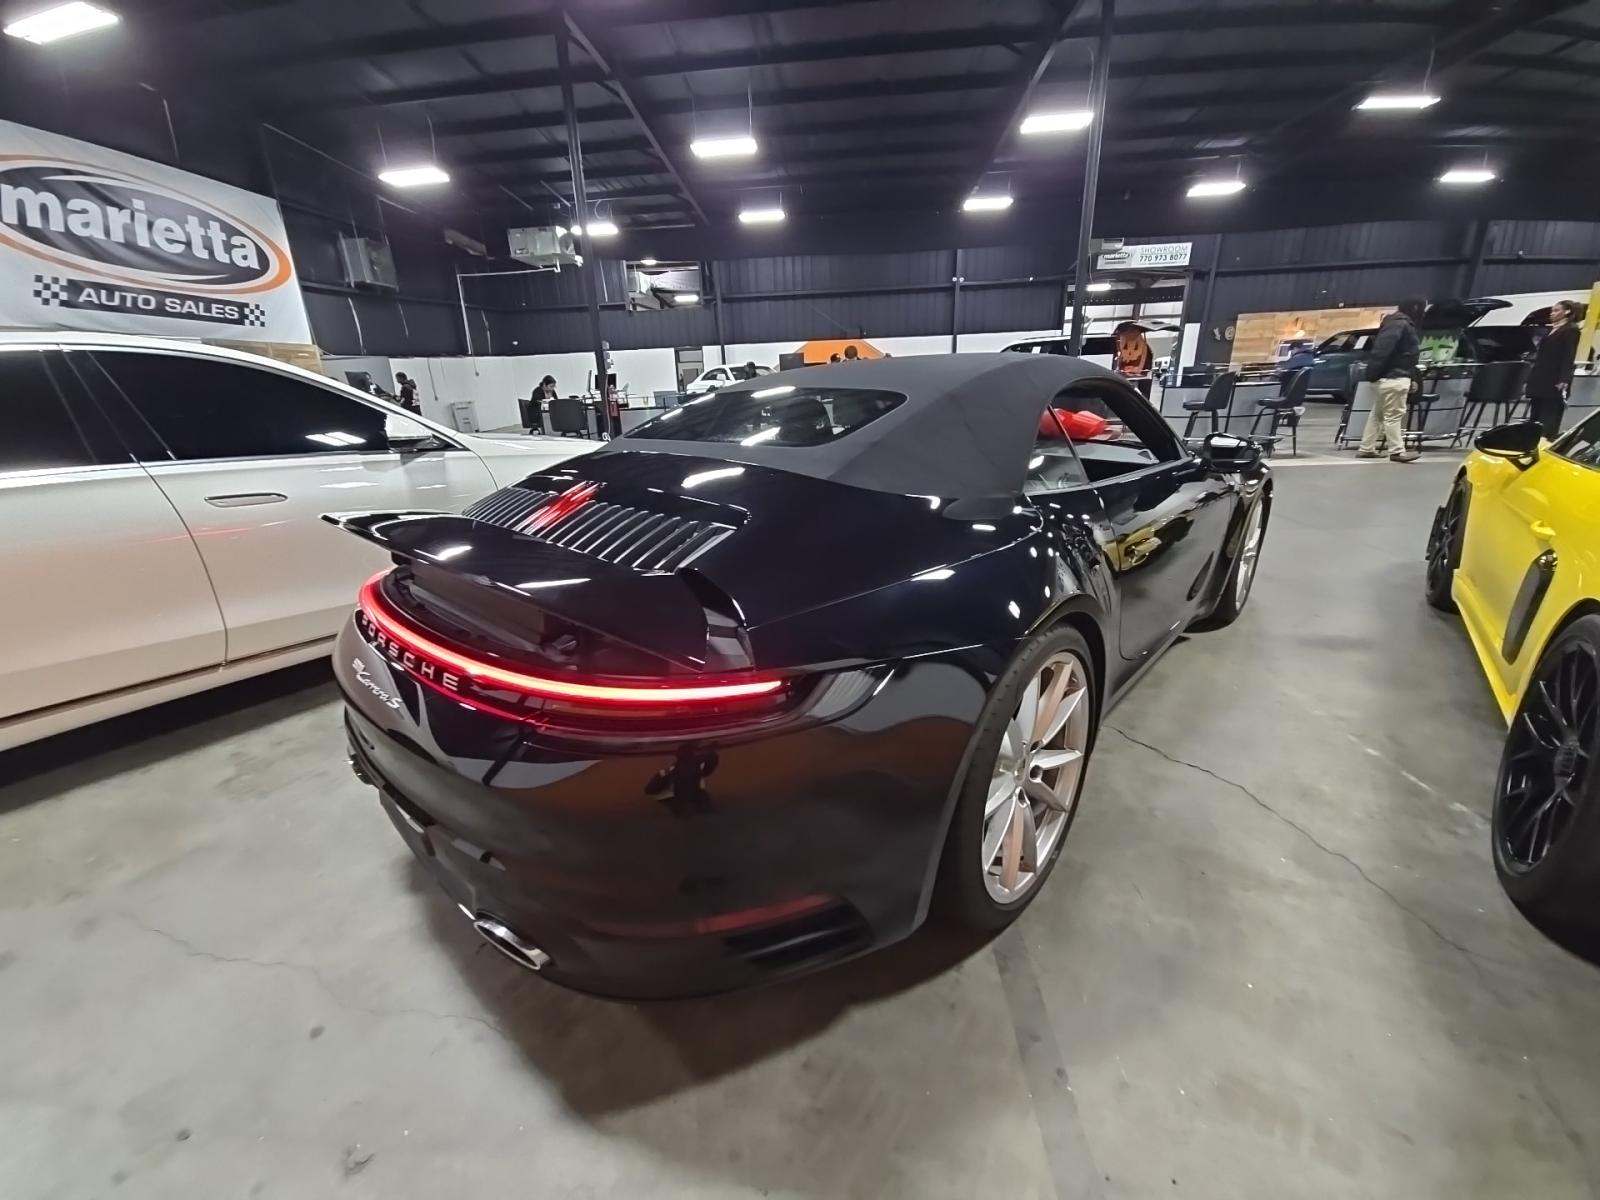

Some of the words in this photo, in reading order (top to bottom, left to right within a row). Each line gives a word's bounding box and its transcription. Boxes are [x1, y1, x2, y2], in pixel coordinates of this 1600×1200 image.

[1, 183, 261, 270] marietta
[78, 287, 156, 310] AUTO
[164, 298, 240, 320] SALES
[361, 614, 460, 692] PORSCHE
